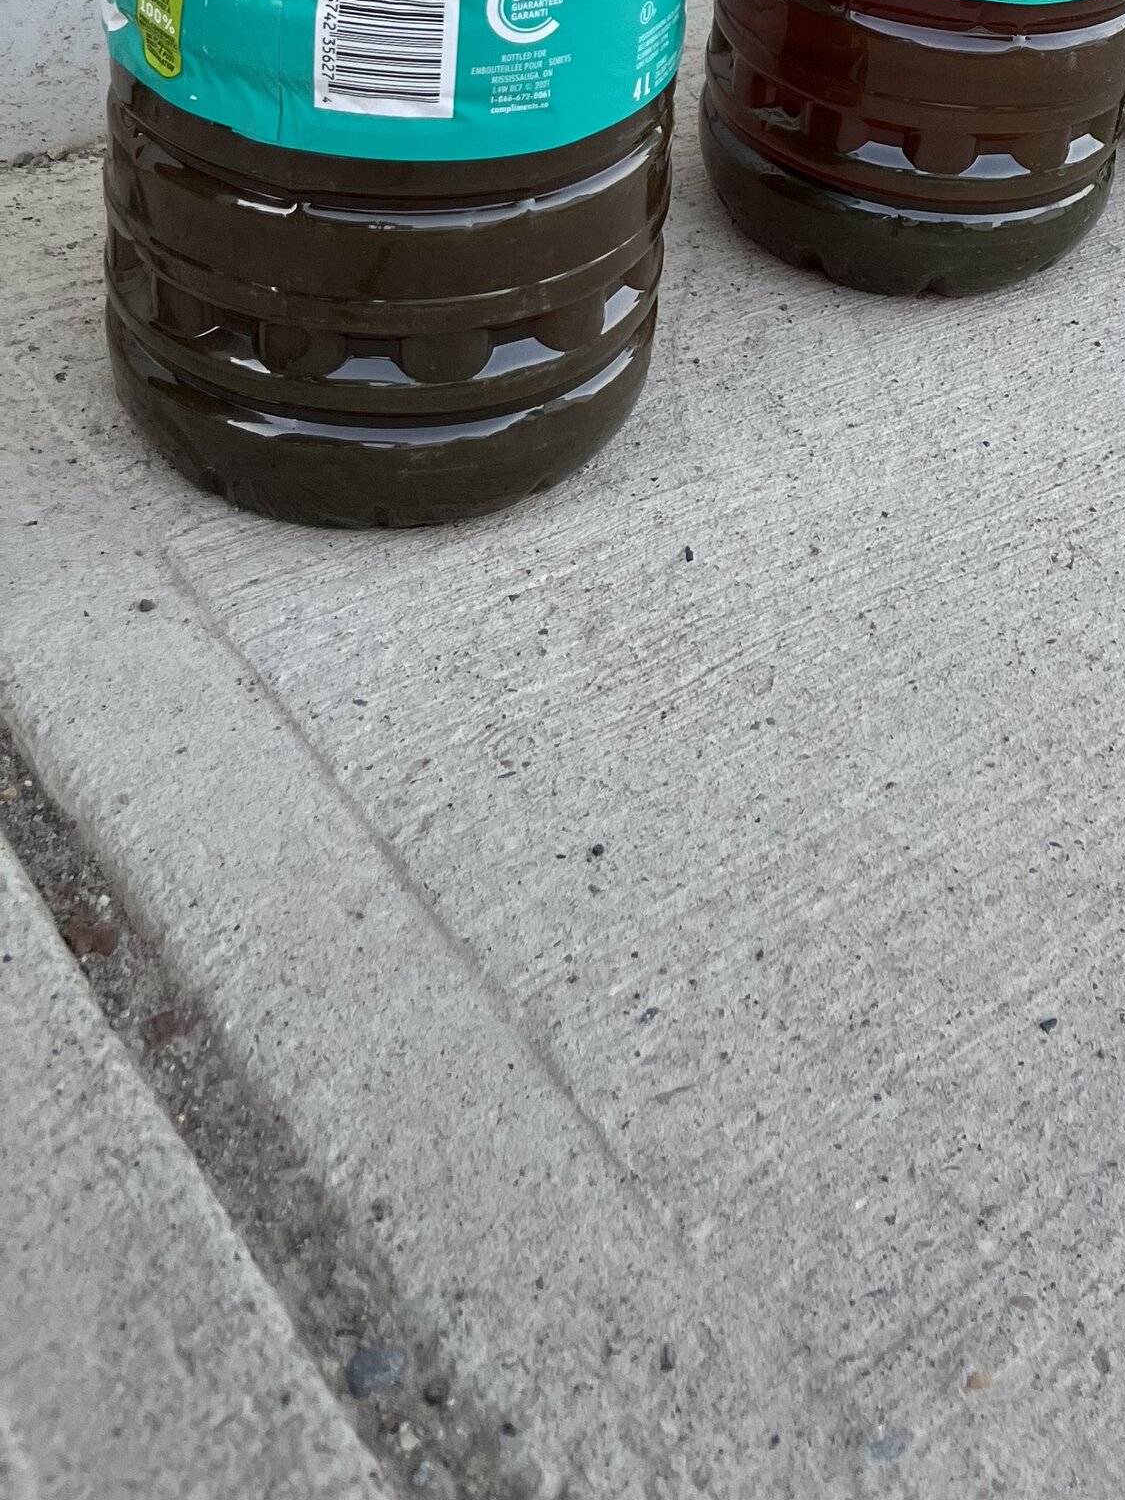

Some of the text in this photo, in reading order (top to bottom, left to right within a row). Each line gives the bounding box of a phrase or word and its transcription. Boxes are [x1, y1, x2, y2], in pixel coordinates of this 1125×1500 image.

[511, 9, 548, 21] GARANTI
[321, 36, 336, 81] 35627
[502, 49, 547, 62] BOTTLED FOR
[490, 102, 549, 114] compliments.co
